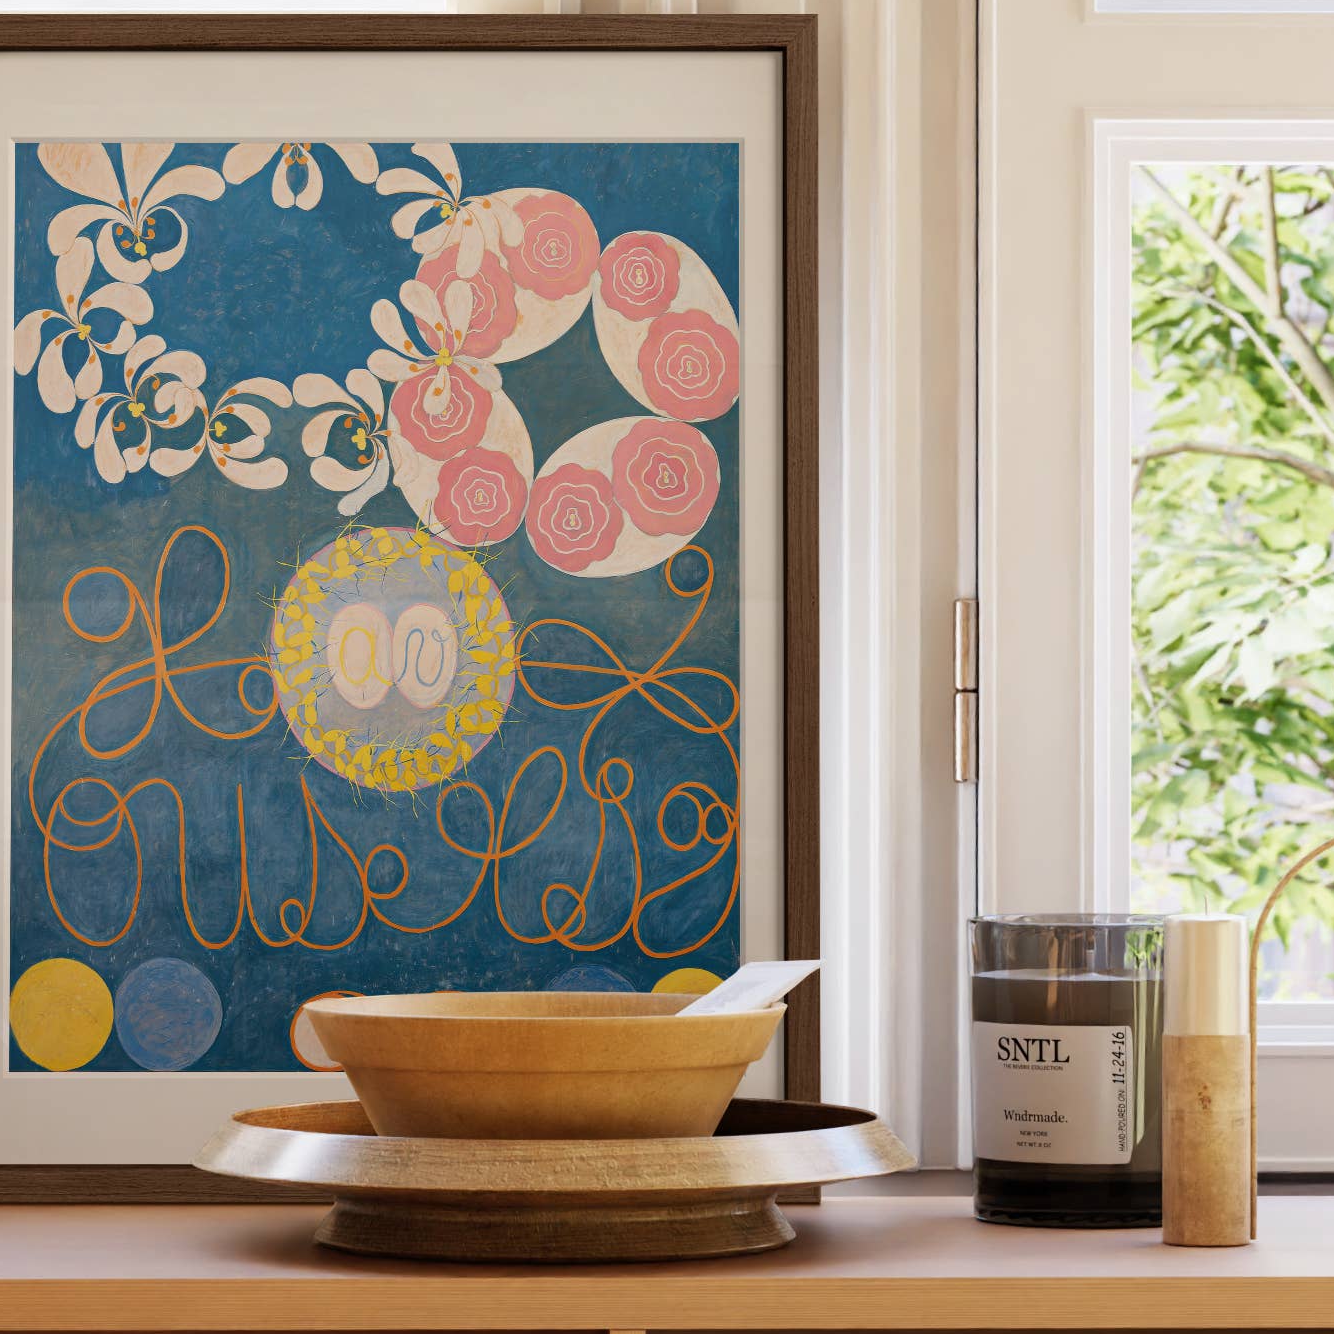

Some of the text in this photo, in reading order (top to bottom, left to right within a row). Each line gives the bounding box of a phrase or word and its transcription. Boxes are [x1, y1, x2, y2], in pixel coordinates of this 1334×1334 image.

[997, 1036, 1070, 1063] SNTL
[1112, 1031, 1125, 1084] 11-24-16
[1003, 1109, 1068, 1123] Wndrmade.
